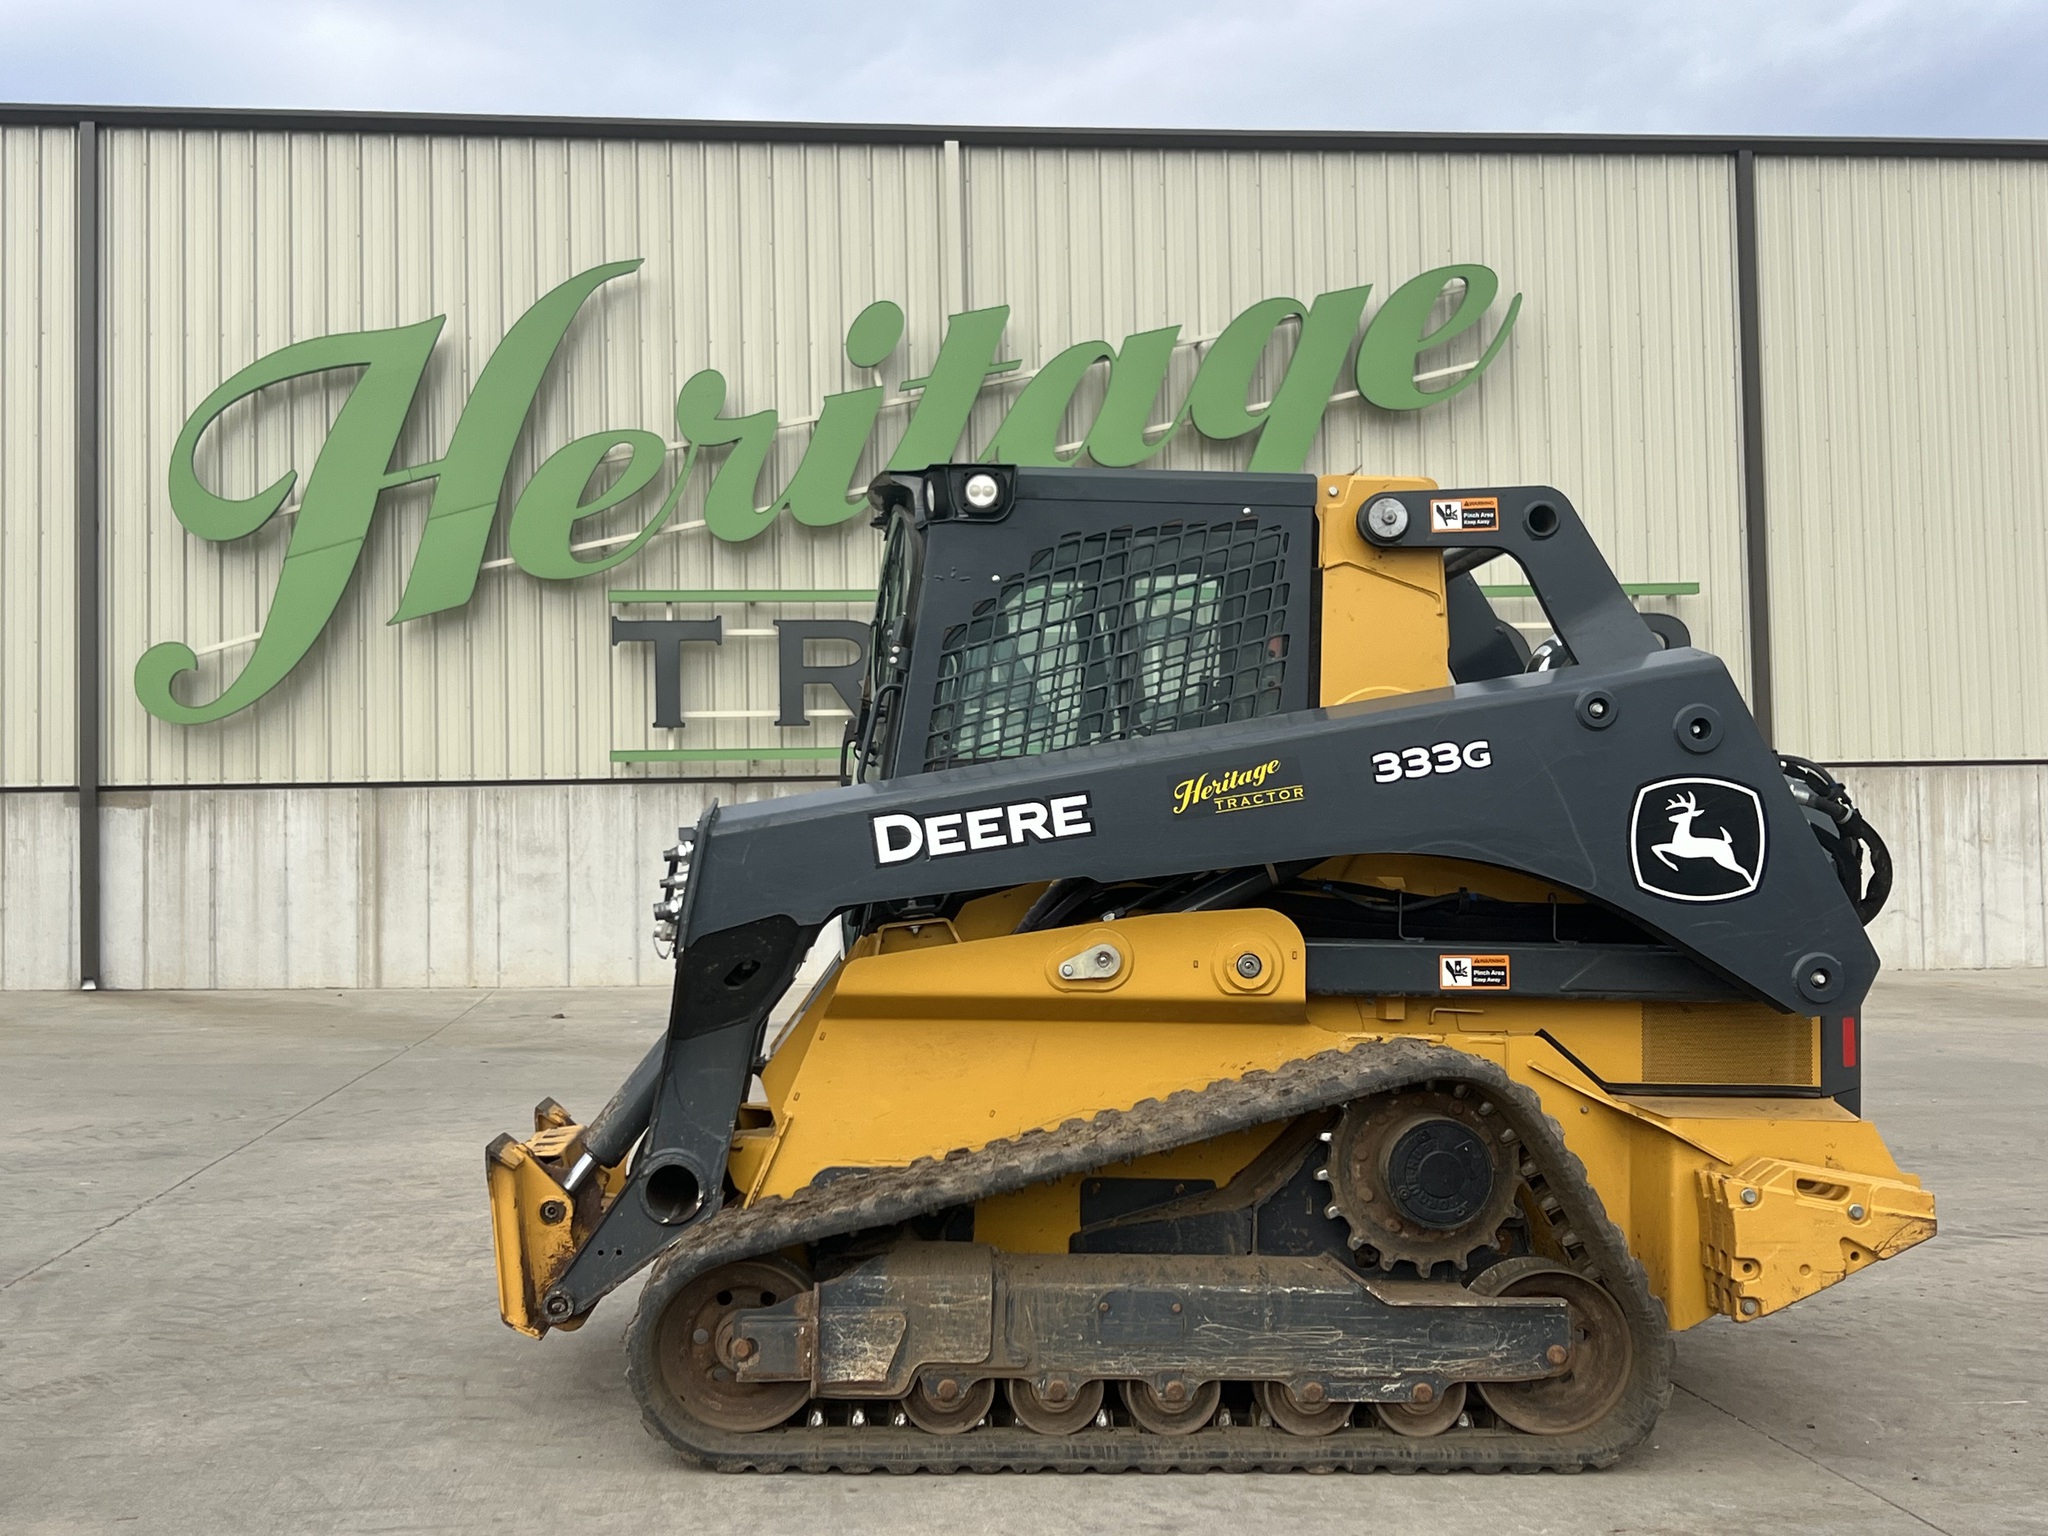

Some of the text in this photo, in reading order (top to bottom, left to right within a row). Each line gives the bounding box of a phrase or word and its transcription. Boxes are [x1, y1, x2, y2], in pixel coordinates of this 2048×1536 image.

[134, 257, 1523, 726] Heritage
[1173, 759, 1281, 814] Heritage
[1372, 740, 1491, 783] 333G
[1214, 787, 1304, 811] TRACTOR
[873, 794, 1092, 864] DEERE
